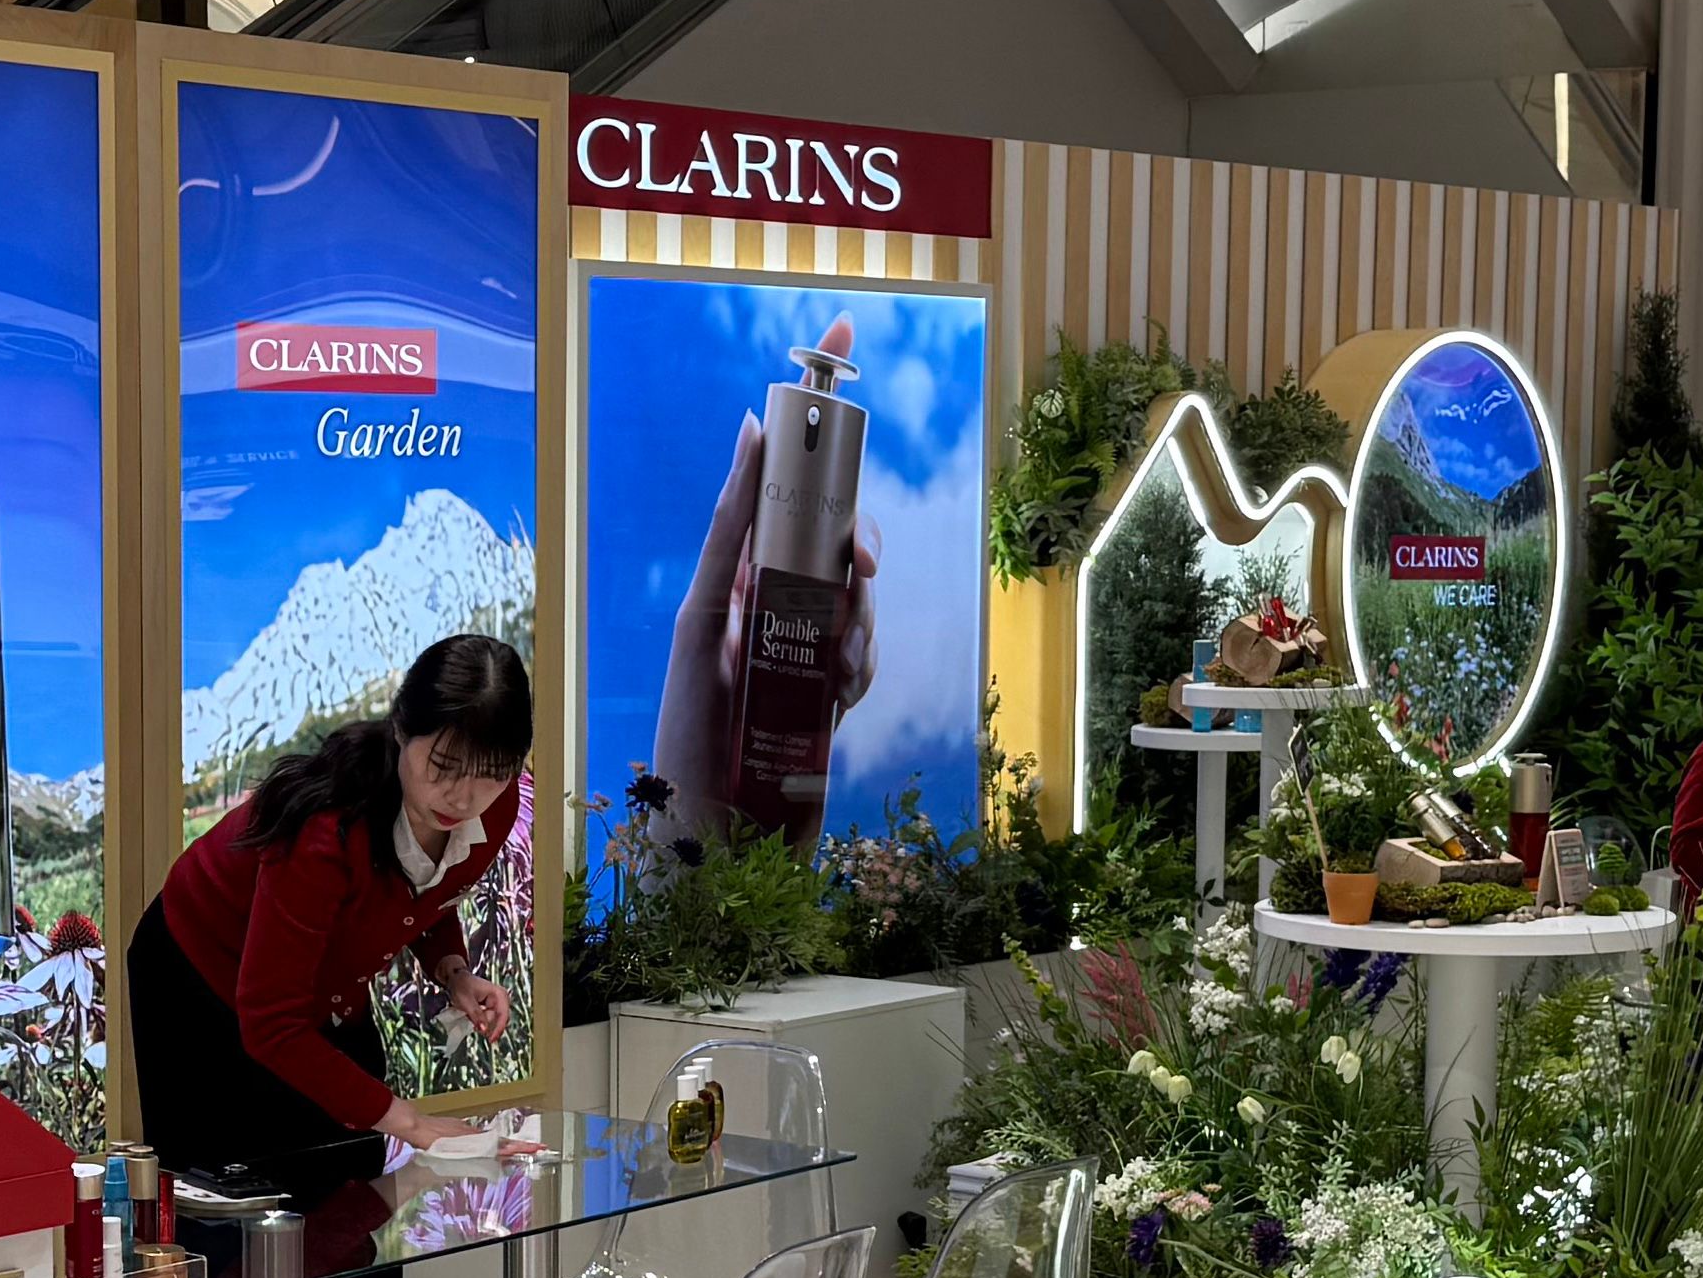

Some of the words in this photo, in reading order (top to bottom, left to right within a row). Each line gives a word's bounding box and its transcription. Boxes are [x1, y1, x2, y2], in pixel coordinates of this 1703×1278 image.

[576, 117, 903, 212] CLARINS
[248, 337, 424, 377] CLARINS
[316, 406, 463, 458] Garden
[1395, 545, 1479, 568] CLARINS
[1433, 584, 1457, 607] WE
[1459, 584, 1497, 607] CARE
[761, 610, 820, 643] Double
[761, 633, 815, 665] Serum
